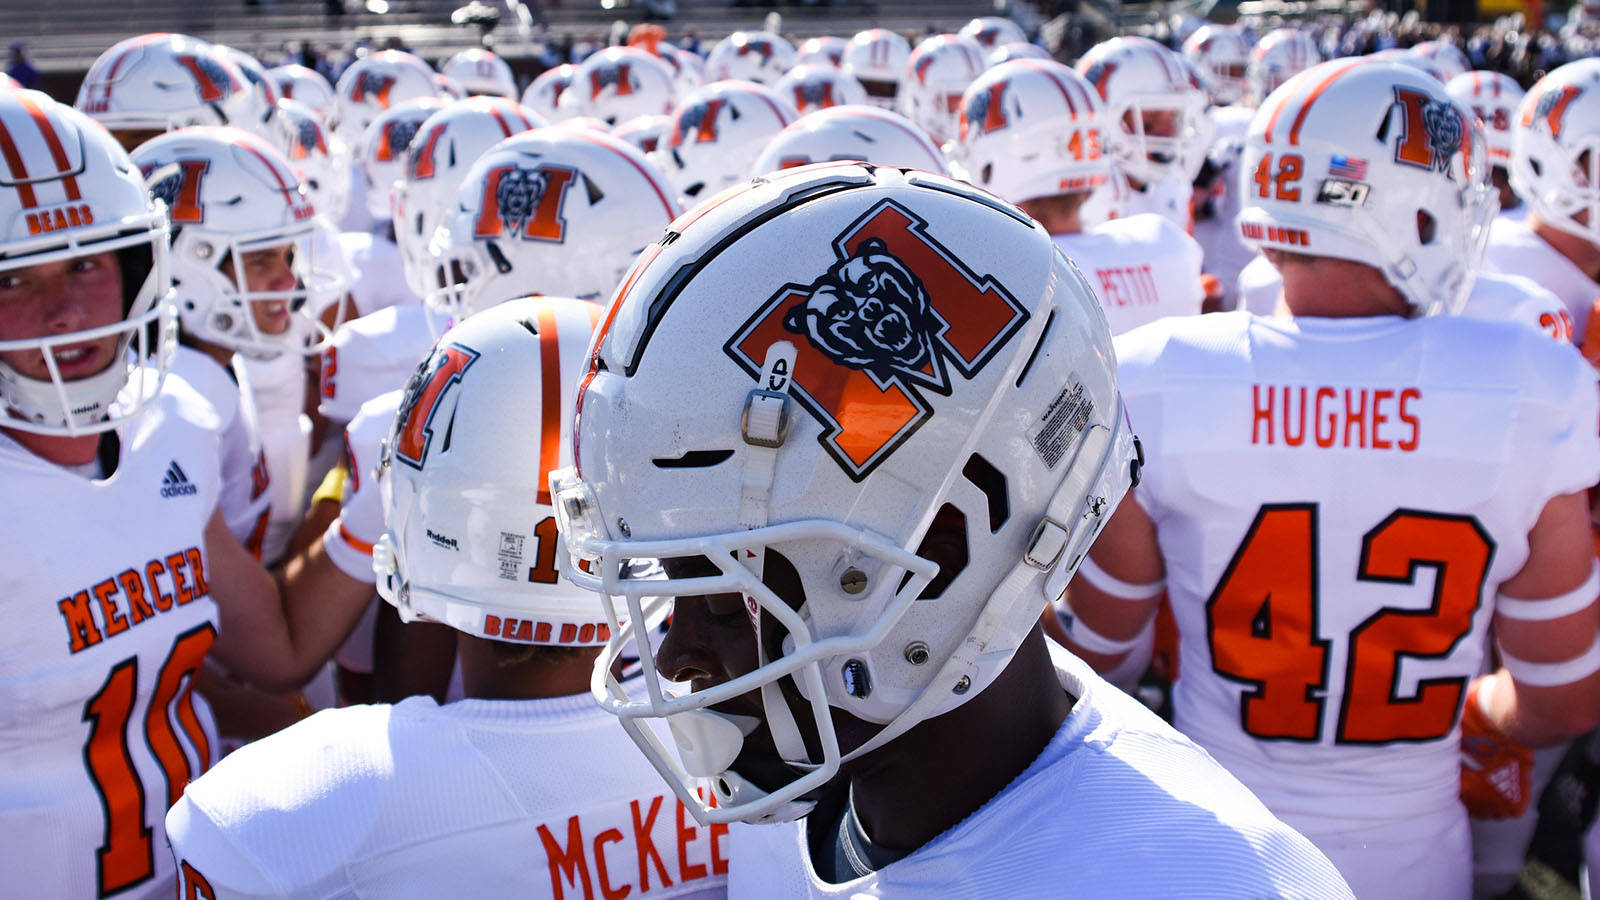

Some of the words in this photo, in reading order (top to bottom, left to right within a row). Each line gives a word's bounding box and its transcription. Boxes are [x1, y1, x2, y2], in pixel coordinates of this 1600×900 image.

[1254, 153, 1304, 202] 42
[25, 204, 95, 236] BEARS
[1251, 384, 1422, 452] HUGHES
[160, 484, 197, 498] adidas
[426, 529, 457, 547] Riddell
[57, 546, 210, 655] MERCER
[1204, 501, 1498, 747] 42
[484, 614, 552, 643] BEAR
[559, 622, 613, 644] DOW
[81, 620, 218, 899] 10
